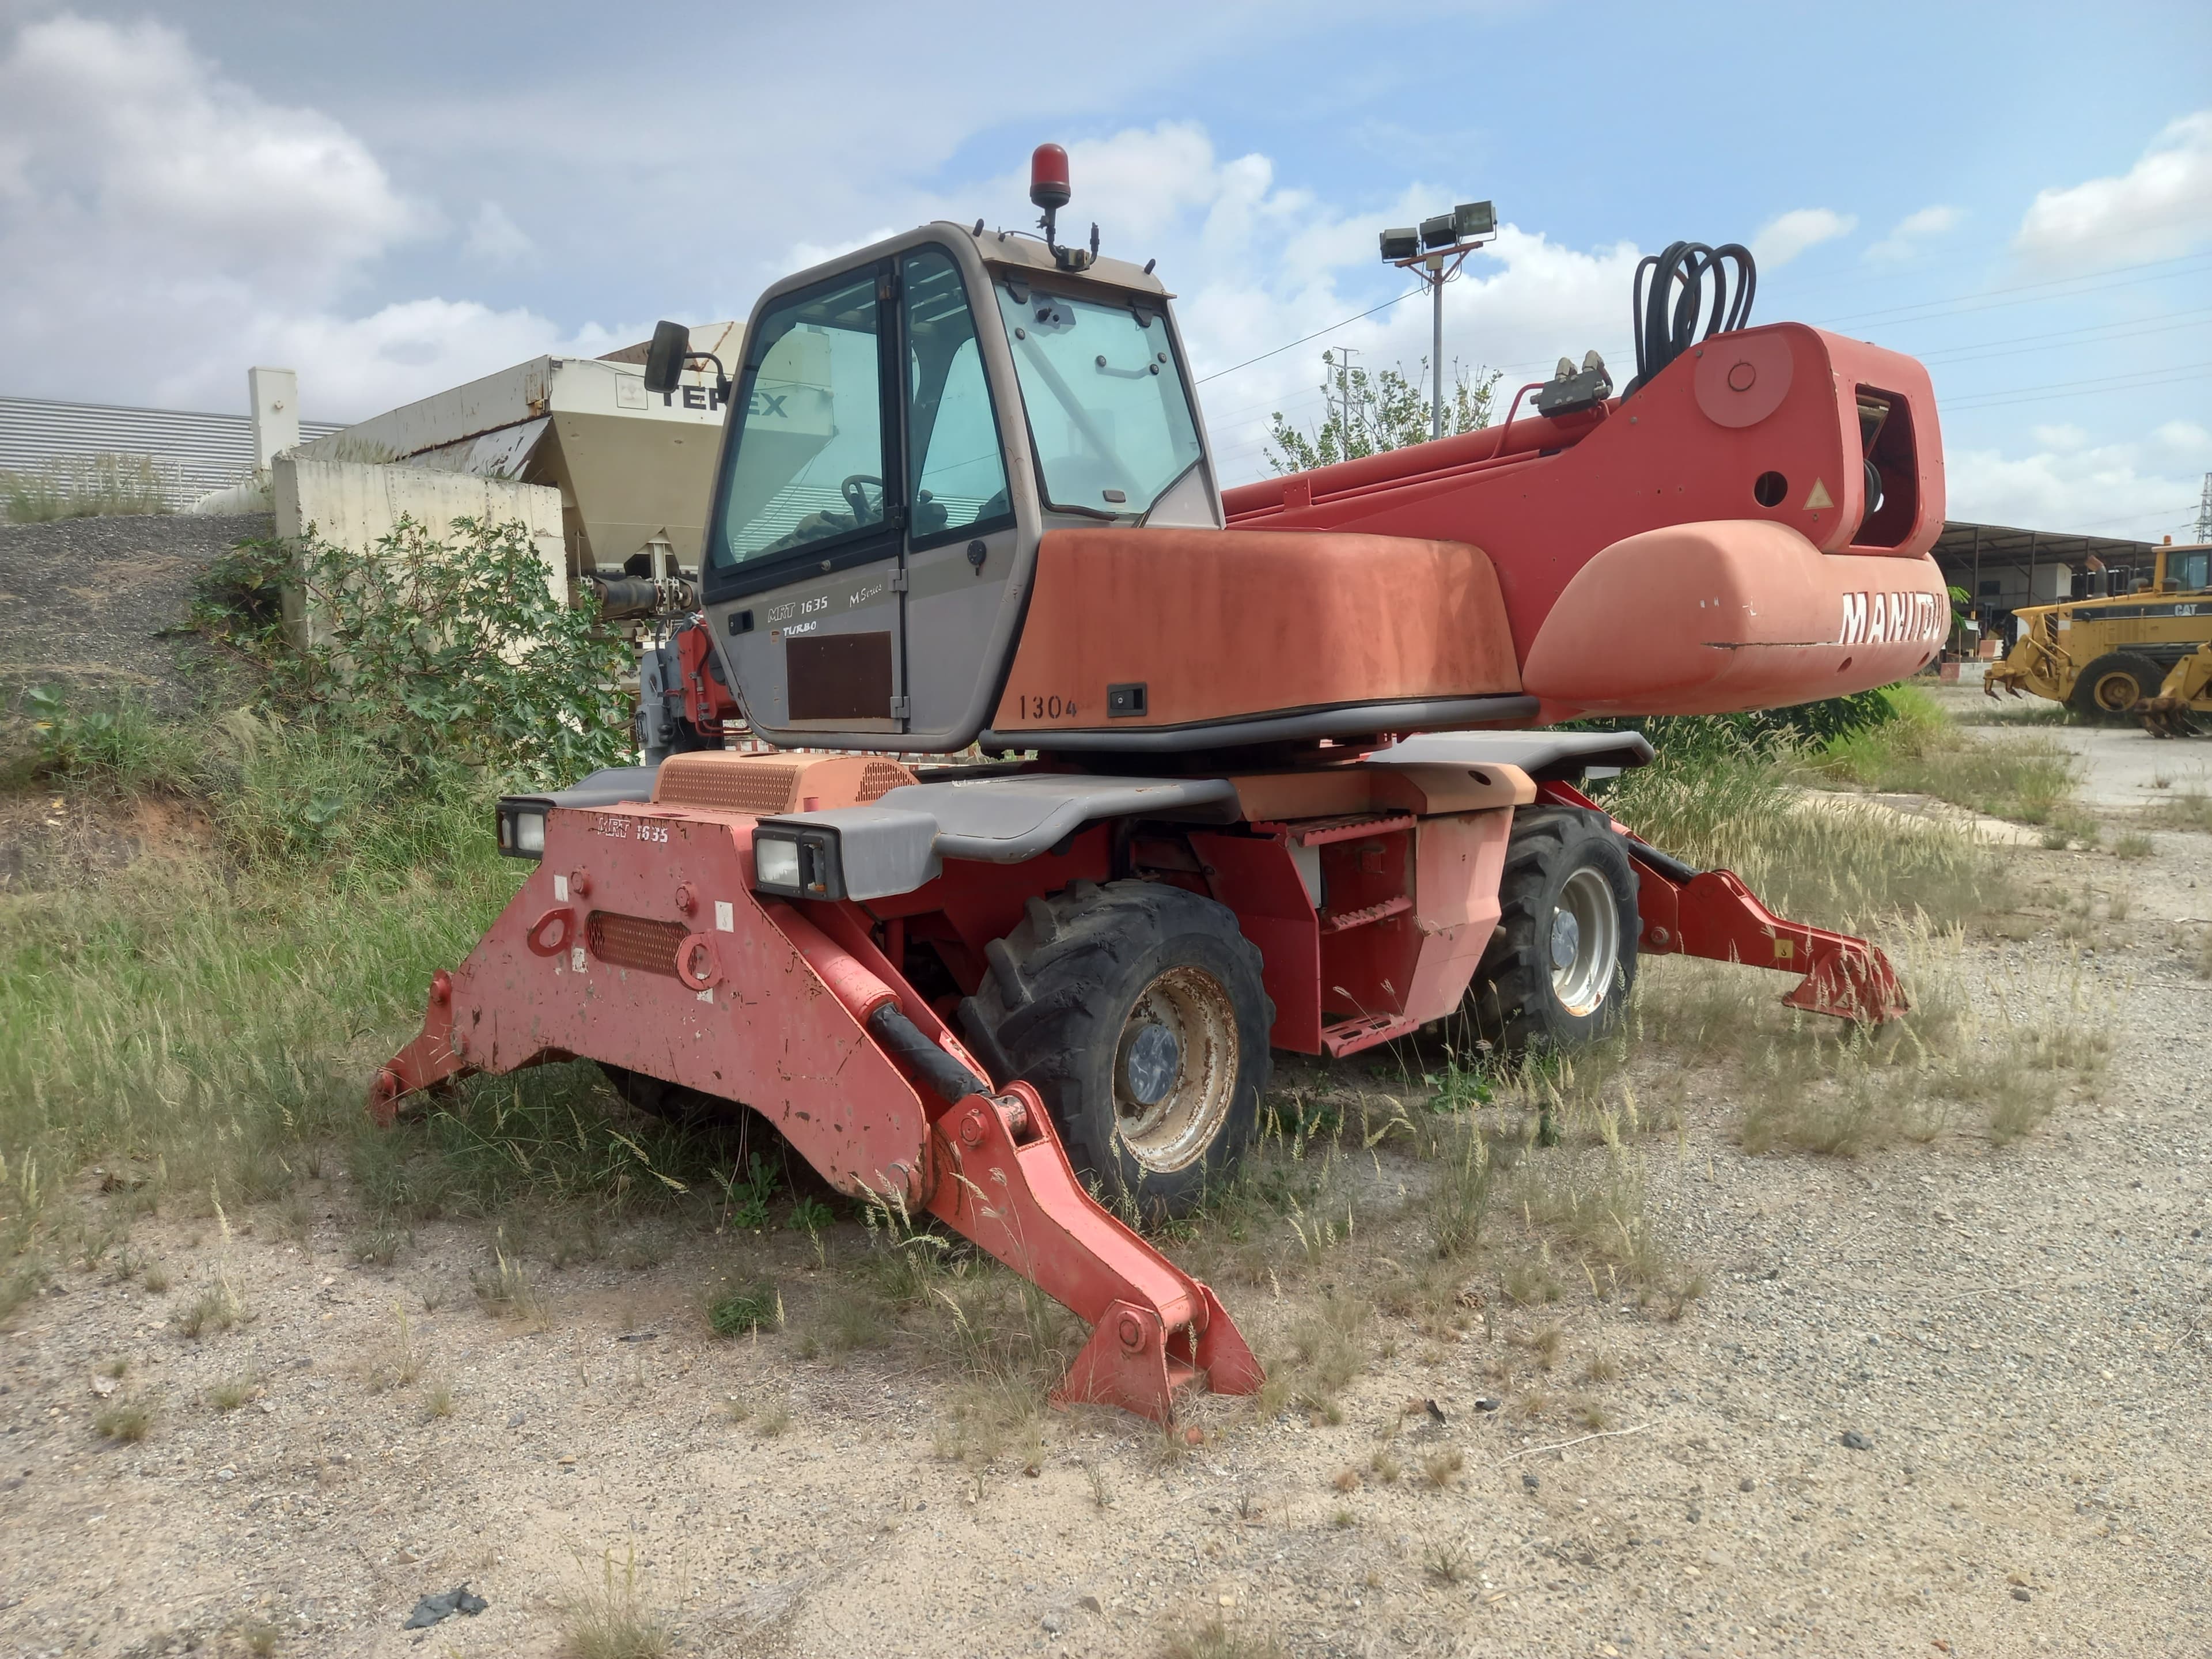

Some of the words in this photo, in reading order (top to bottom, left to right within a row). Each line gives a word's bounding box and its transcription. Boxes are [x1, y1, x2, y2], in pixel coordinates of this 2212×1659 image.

[767, 602, 796, 623] MRT
[801, 596, 828, 614] 1635
[2175, 604, 2198, 616] CAT
[783, 621, 817, 637] TURBO
[1020, 695, 1077, 719] 1304
[597, 817, 631, 838] MRT
[637, 825, 669, 843] 1635
